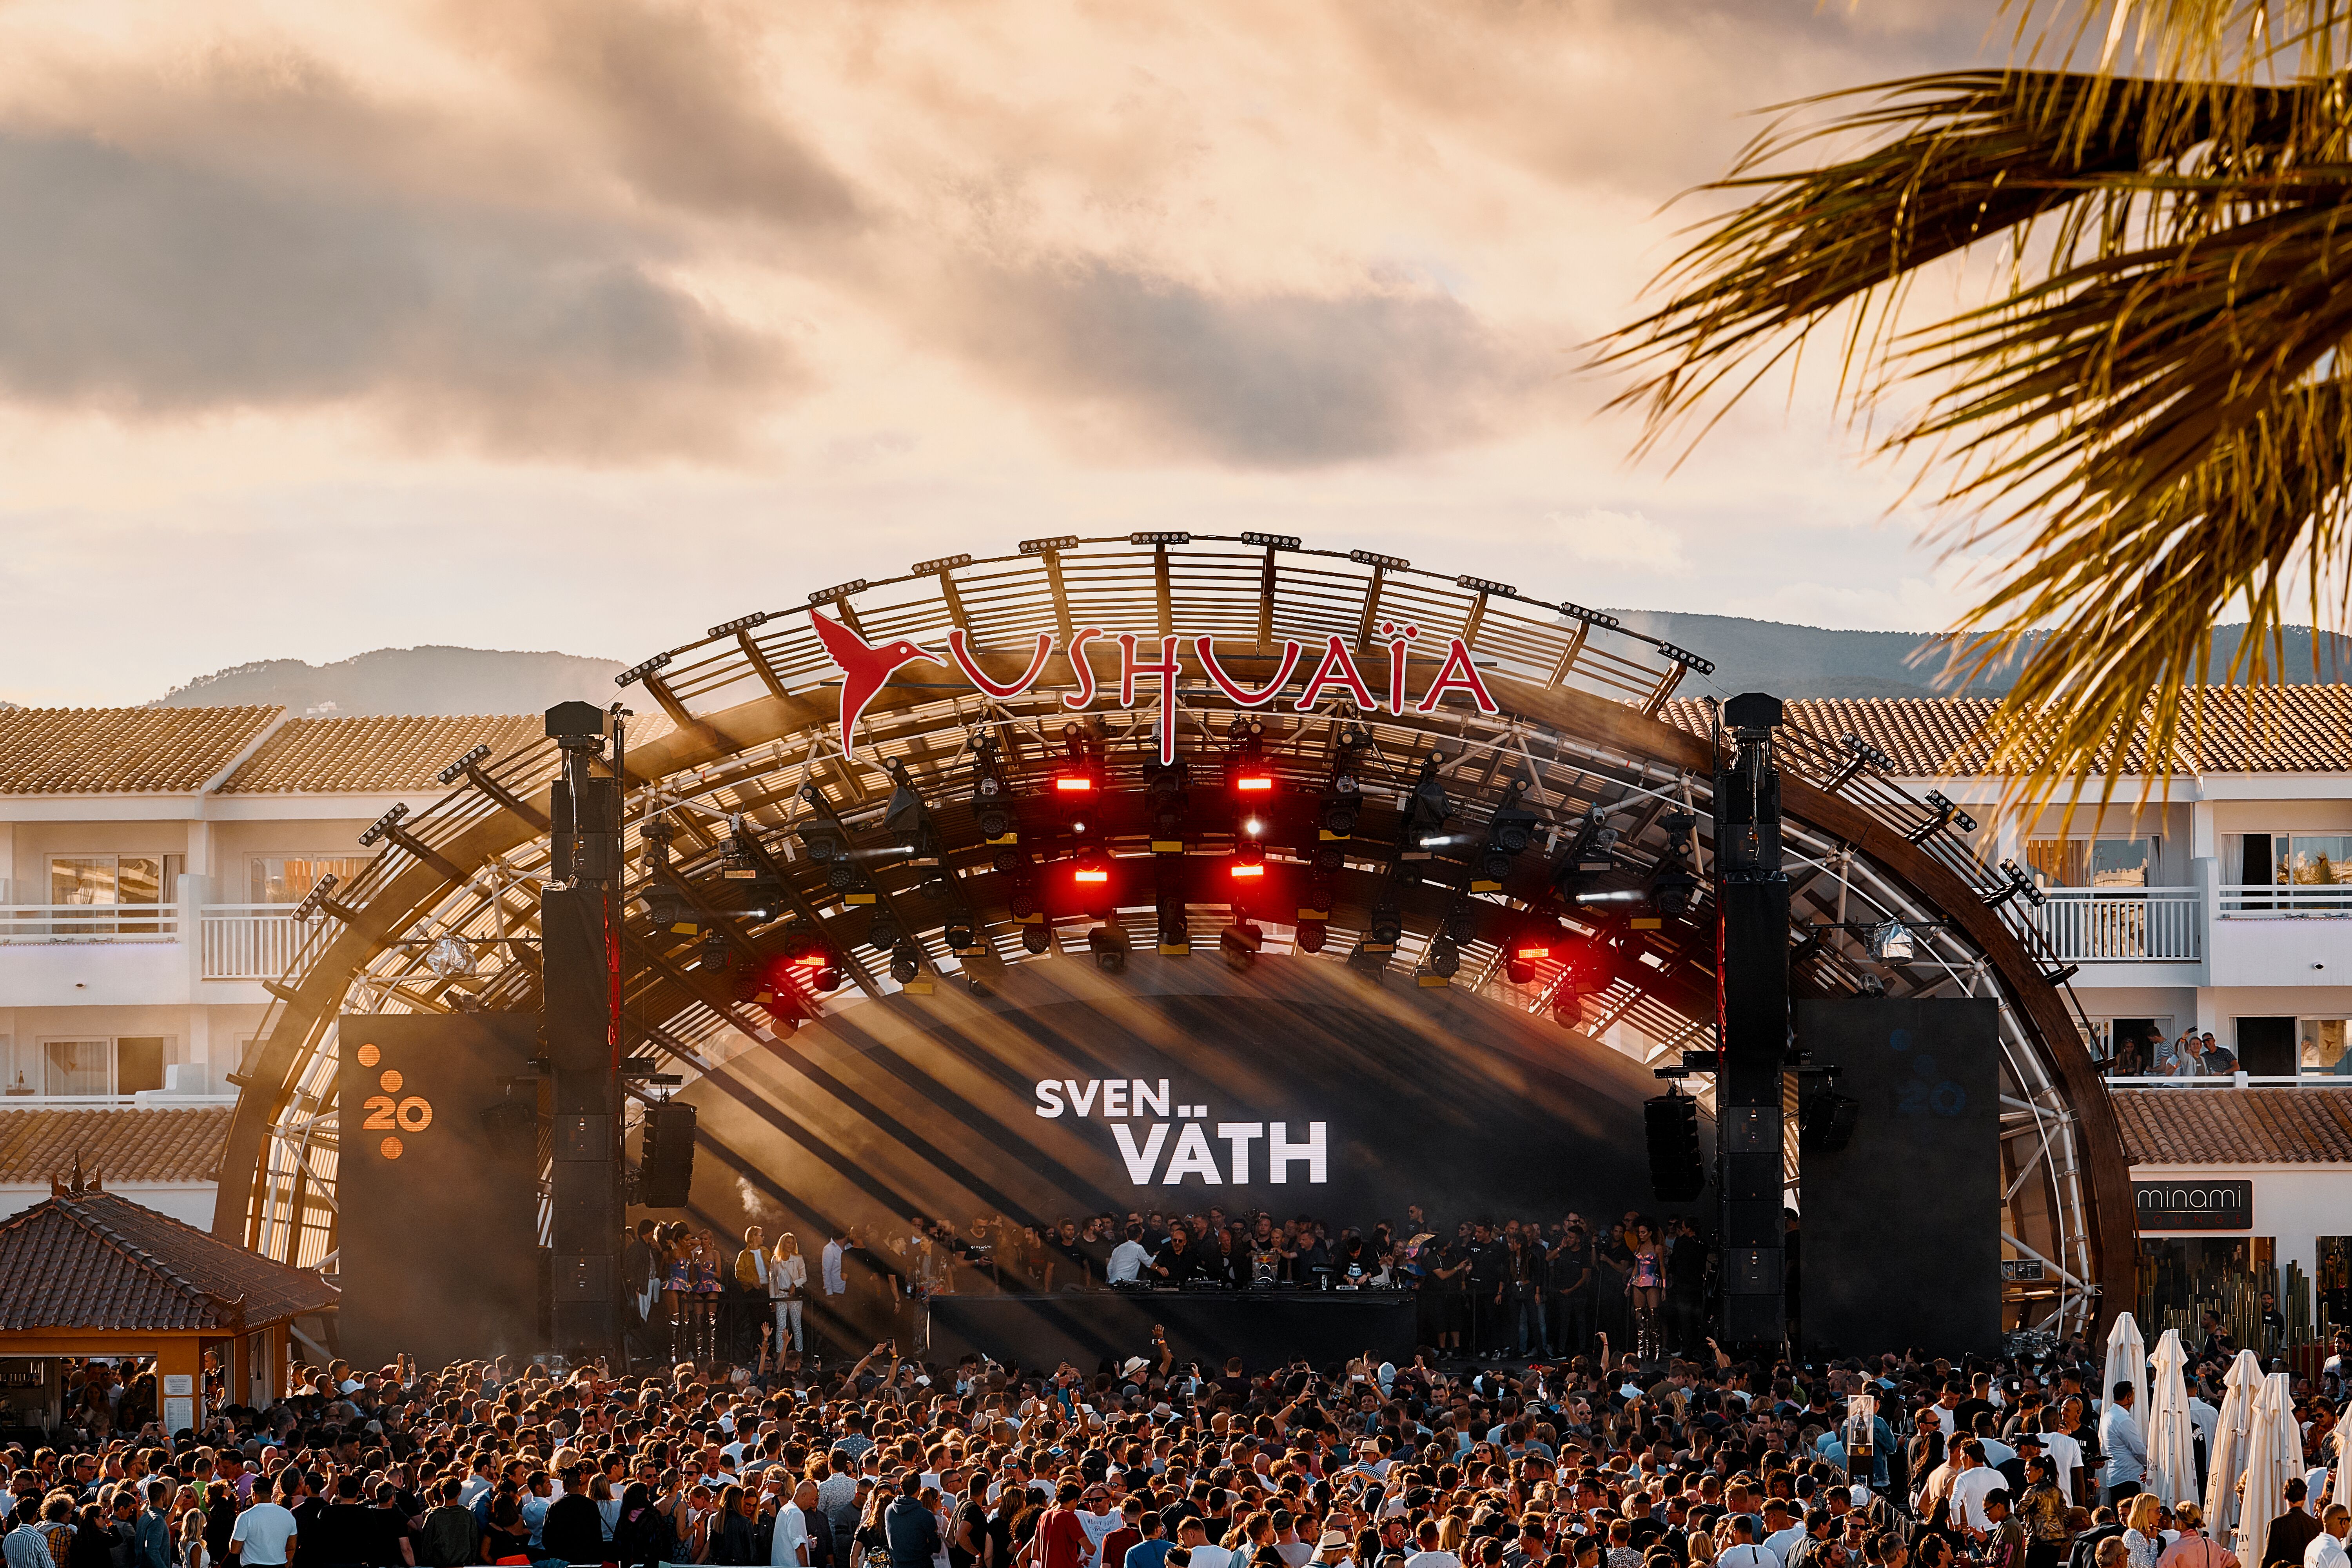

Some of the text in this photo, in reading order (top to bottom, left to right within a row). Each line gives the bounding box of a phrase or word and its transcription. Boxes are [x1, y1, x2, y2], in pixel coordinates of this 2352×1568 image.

[946, 619, 1499, 767] USHUAÏA
[362, 1095, 432, 1132] 20
[1035, 1079, 1170, 1118] SVEN
[1896, 1081, 1967, 1116] 20
[1110, 1105, 1327, 1185] VÄTH
[2138, 1186, 2241, 1208] minami
